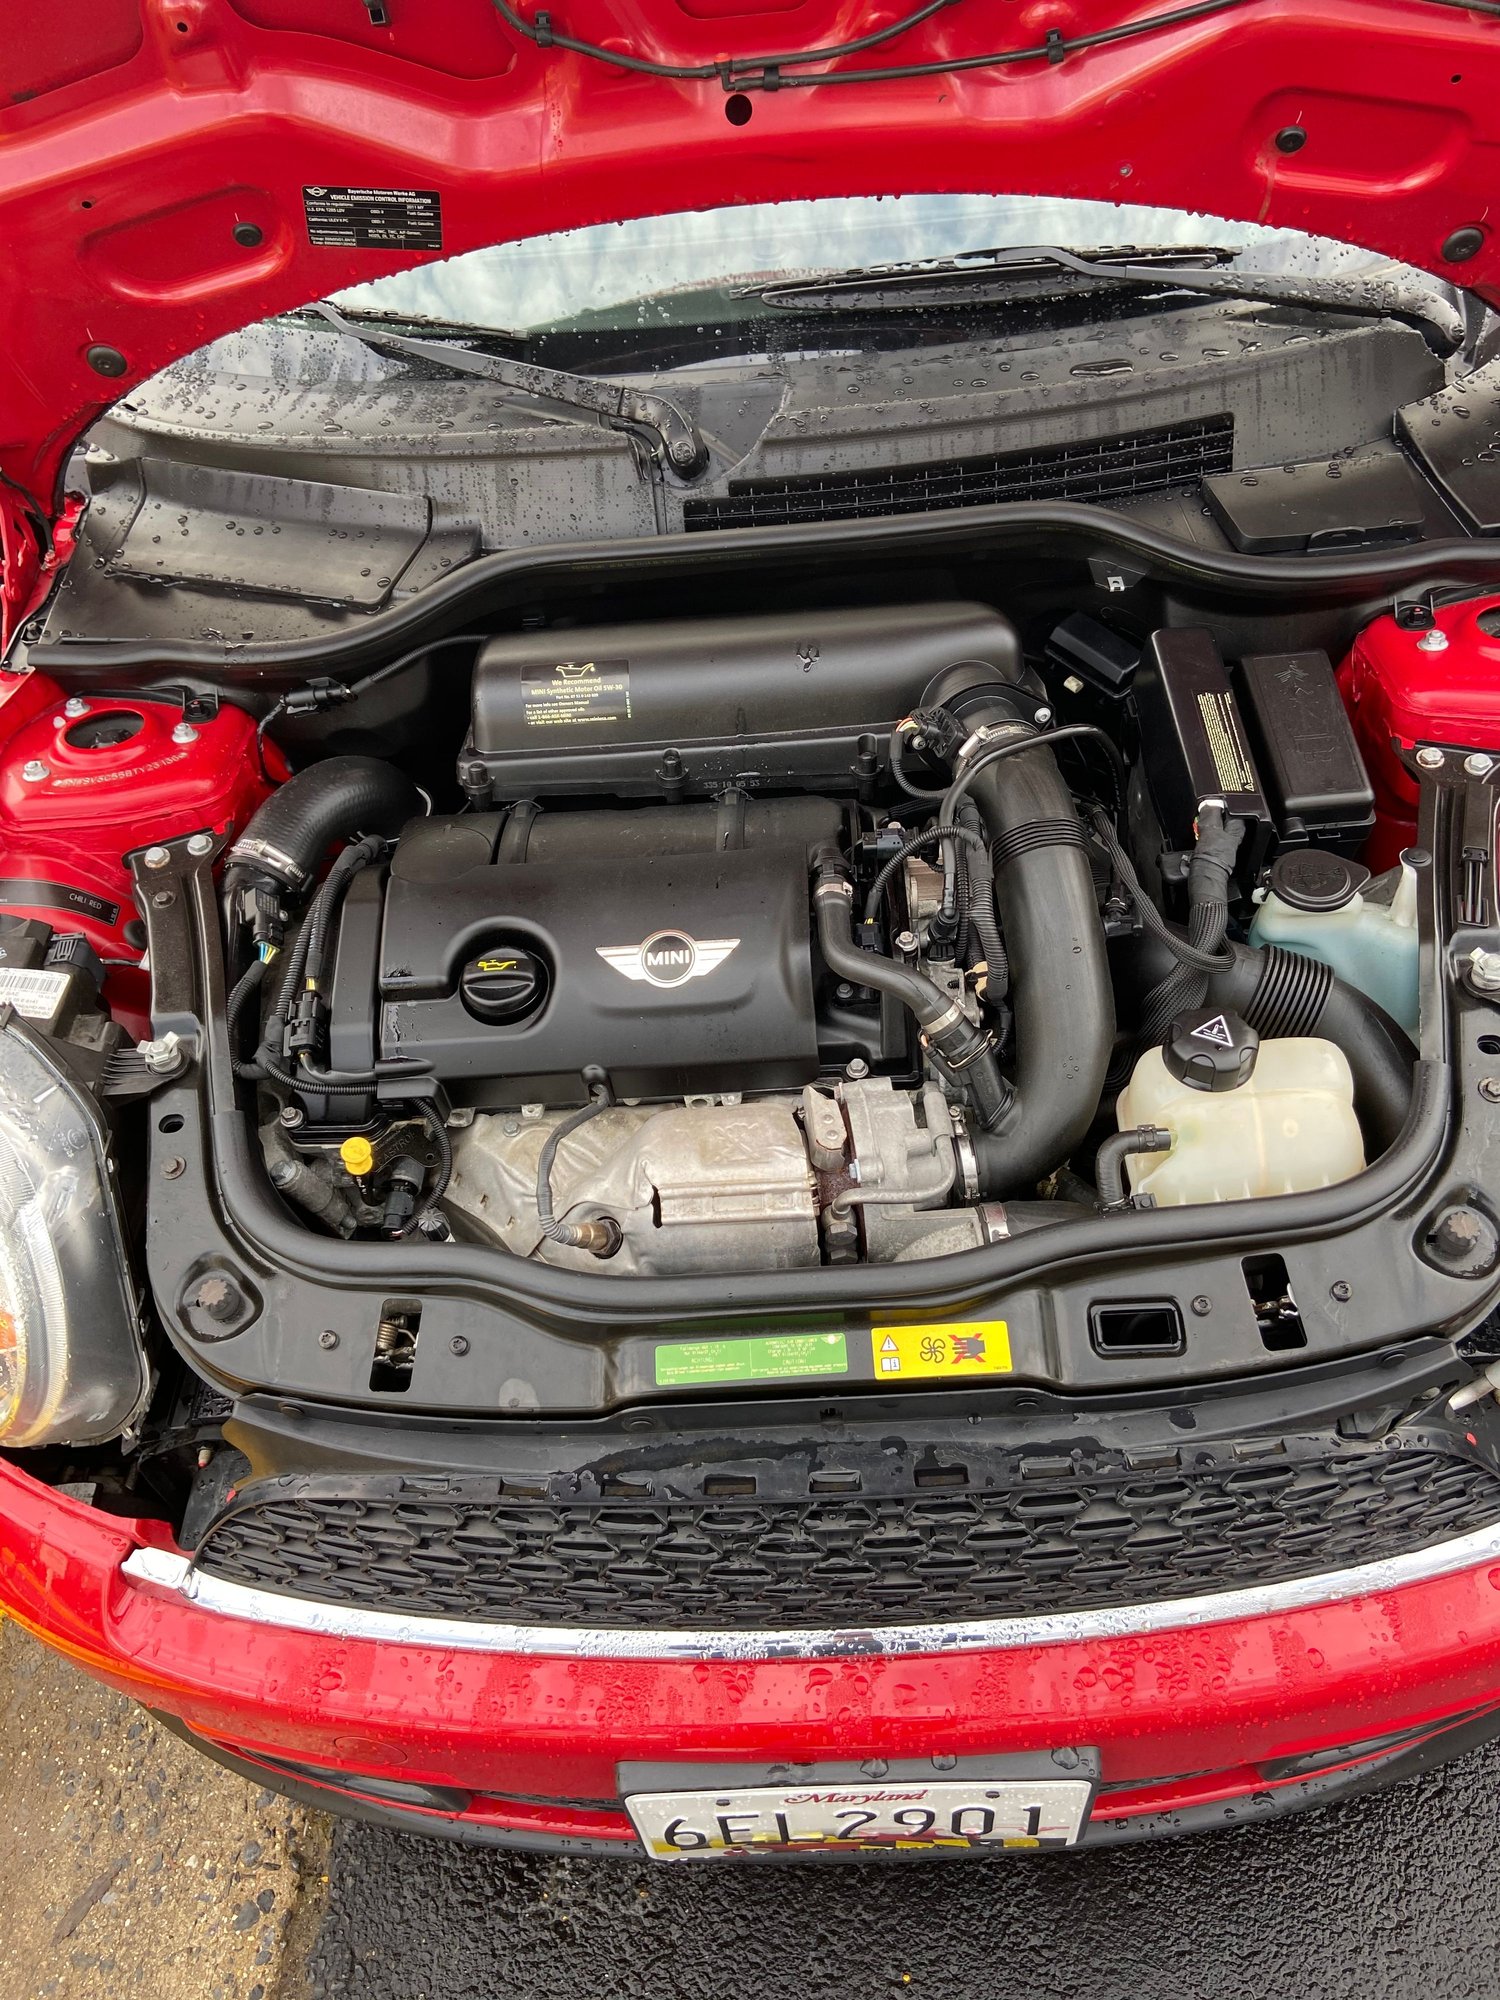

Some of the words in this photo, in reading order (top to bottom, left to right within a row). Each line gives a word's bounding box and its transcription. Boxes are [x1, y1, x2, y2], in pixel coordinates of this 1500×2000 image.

[563, 677, 601, 685] Recommend
[547, 687, 573, 696] Synthetic
[69, 893, 87, 904] CHILI
[89, 900, 102, 910] RED
[647, 949, 690, 966] MINI
[784, 1790, 929, 1806] Maryland
